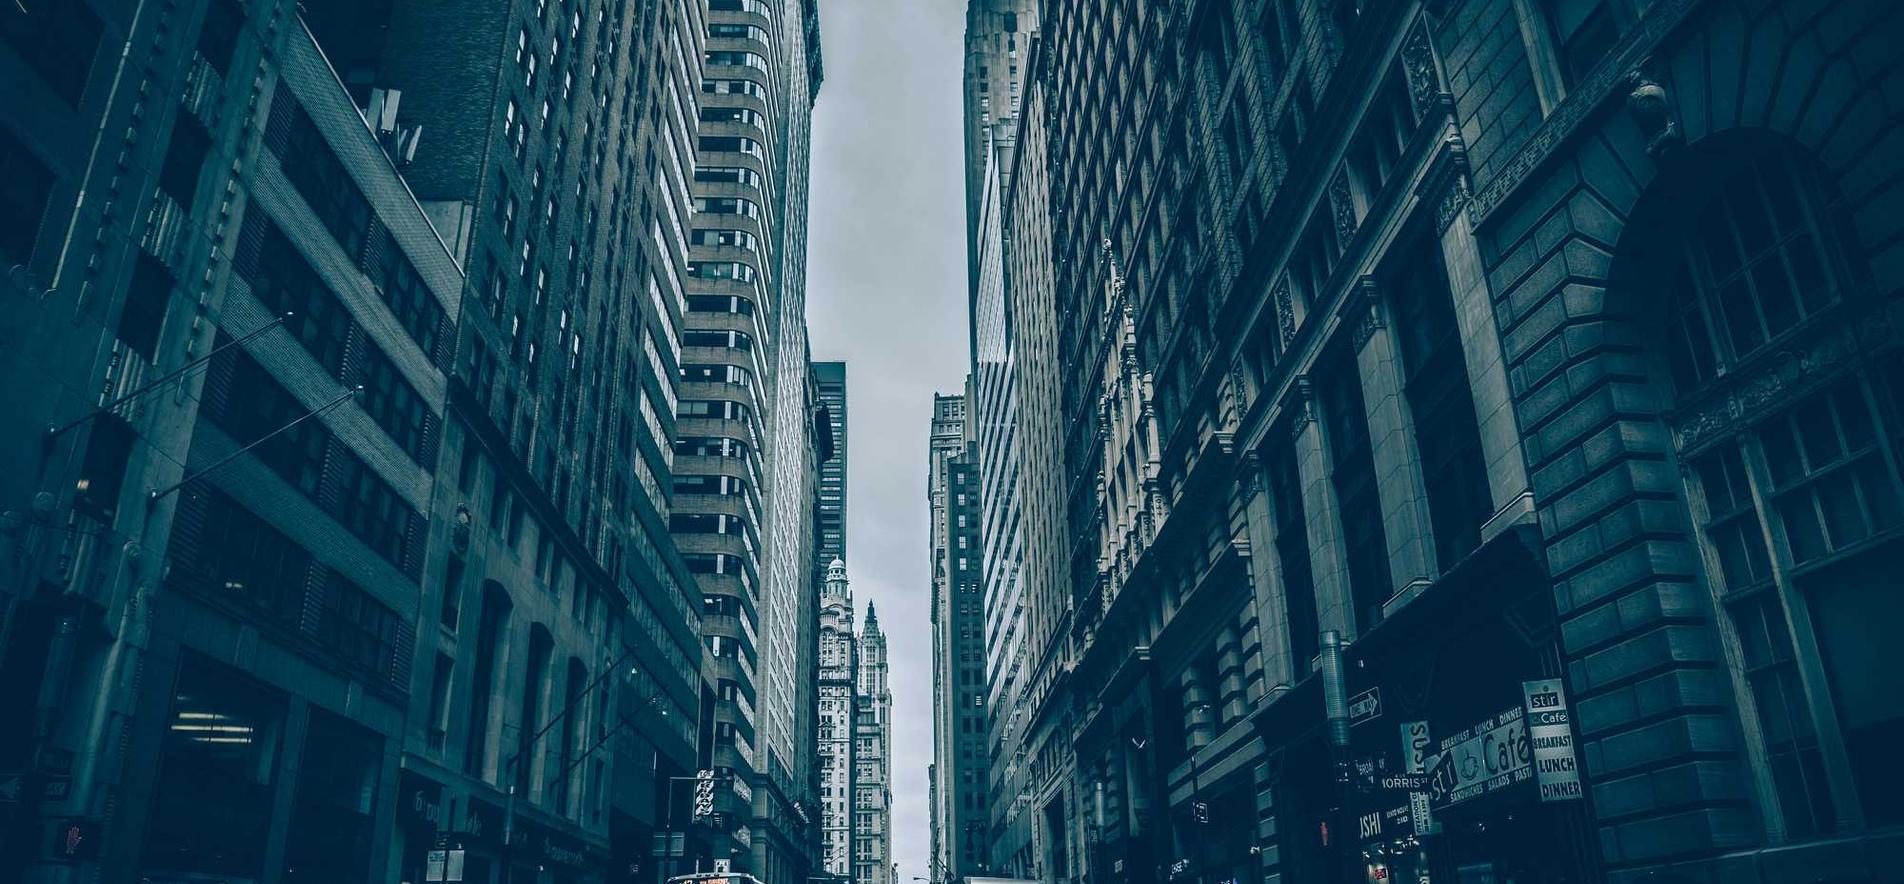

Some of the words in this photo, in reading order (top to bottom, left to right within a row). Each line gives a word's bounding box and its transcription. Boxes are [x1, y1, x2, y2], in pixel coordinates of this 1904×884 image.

[1533, 693, 1557, 707] stir
[1533, 735, 1571, 749] BREAKFAST
[1483, 727, 1529, 775] Café
[1539, 758, 1574, 773] LUNCH
[1450, 784, 1484, 802] SANDWICHES
[1487, 774, 1510, 791] SALADS
[1543, 781, 1580, 798] DINNER
